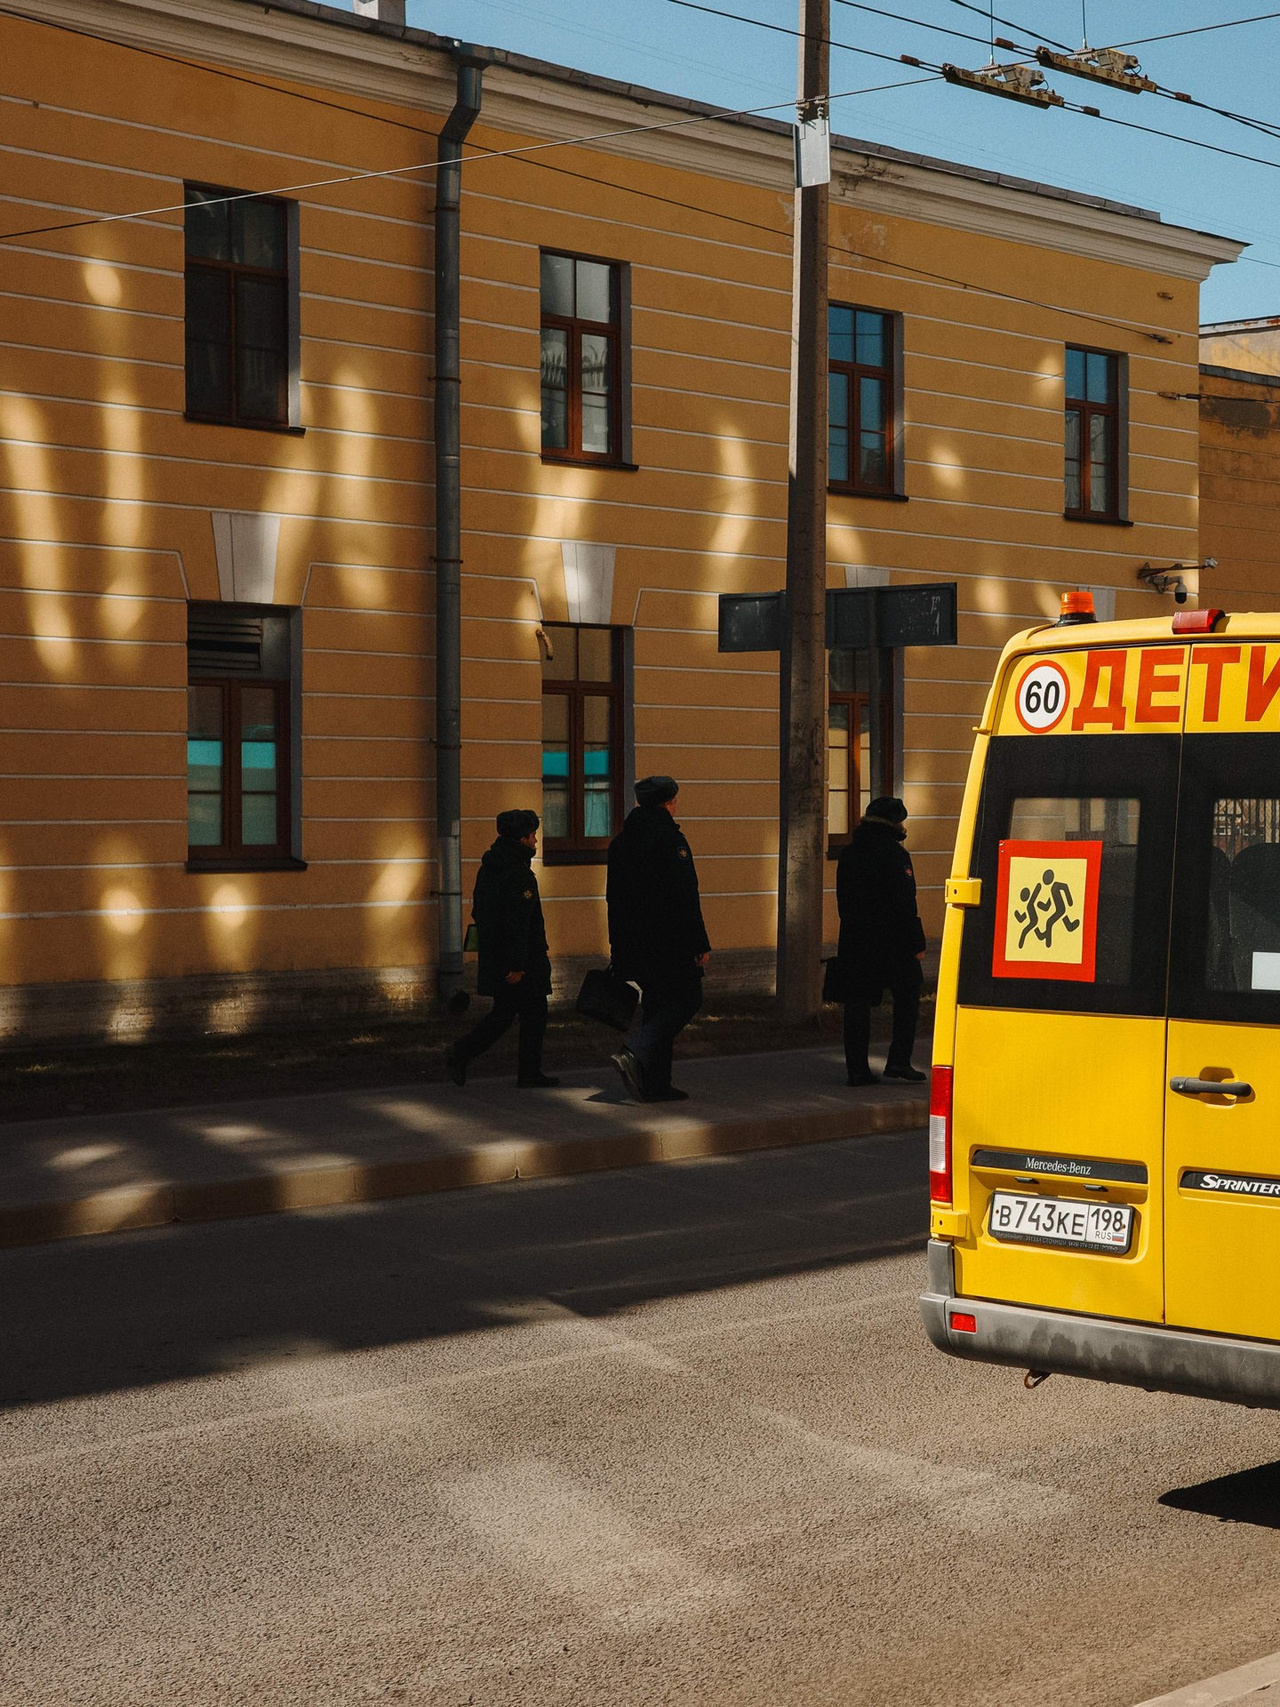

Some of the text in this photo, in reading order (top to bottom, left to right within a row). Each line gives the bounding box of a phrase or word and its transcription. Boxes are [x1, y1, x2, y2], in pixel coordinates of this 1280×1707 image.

[1024, 680, 1061, 714] 60
[1025, 1157, 1092, 1175] Mercedes-Benz
[1090, 1207, 1124, 1233] 198
[1095, 1230, 1112, 1241] RUS
